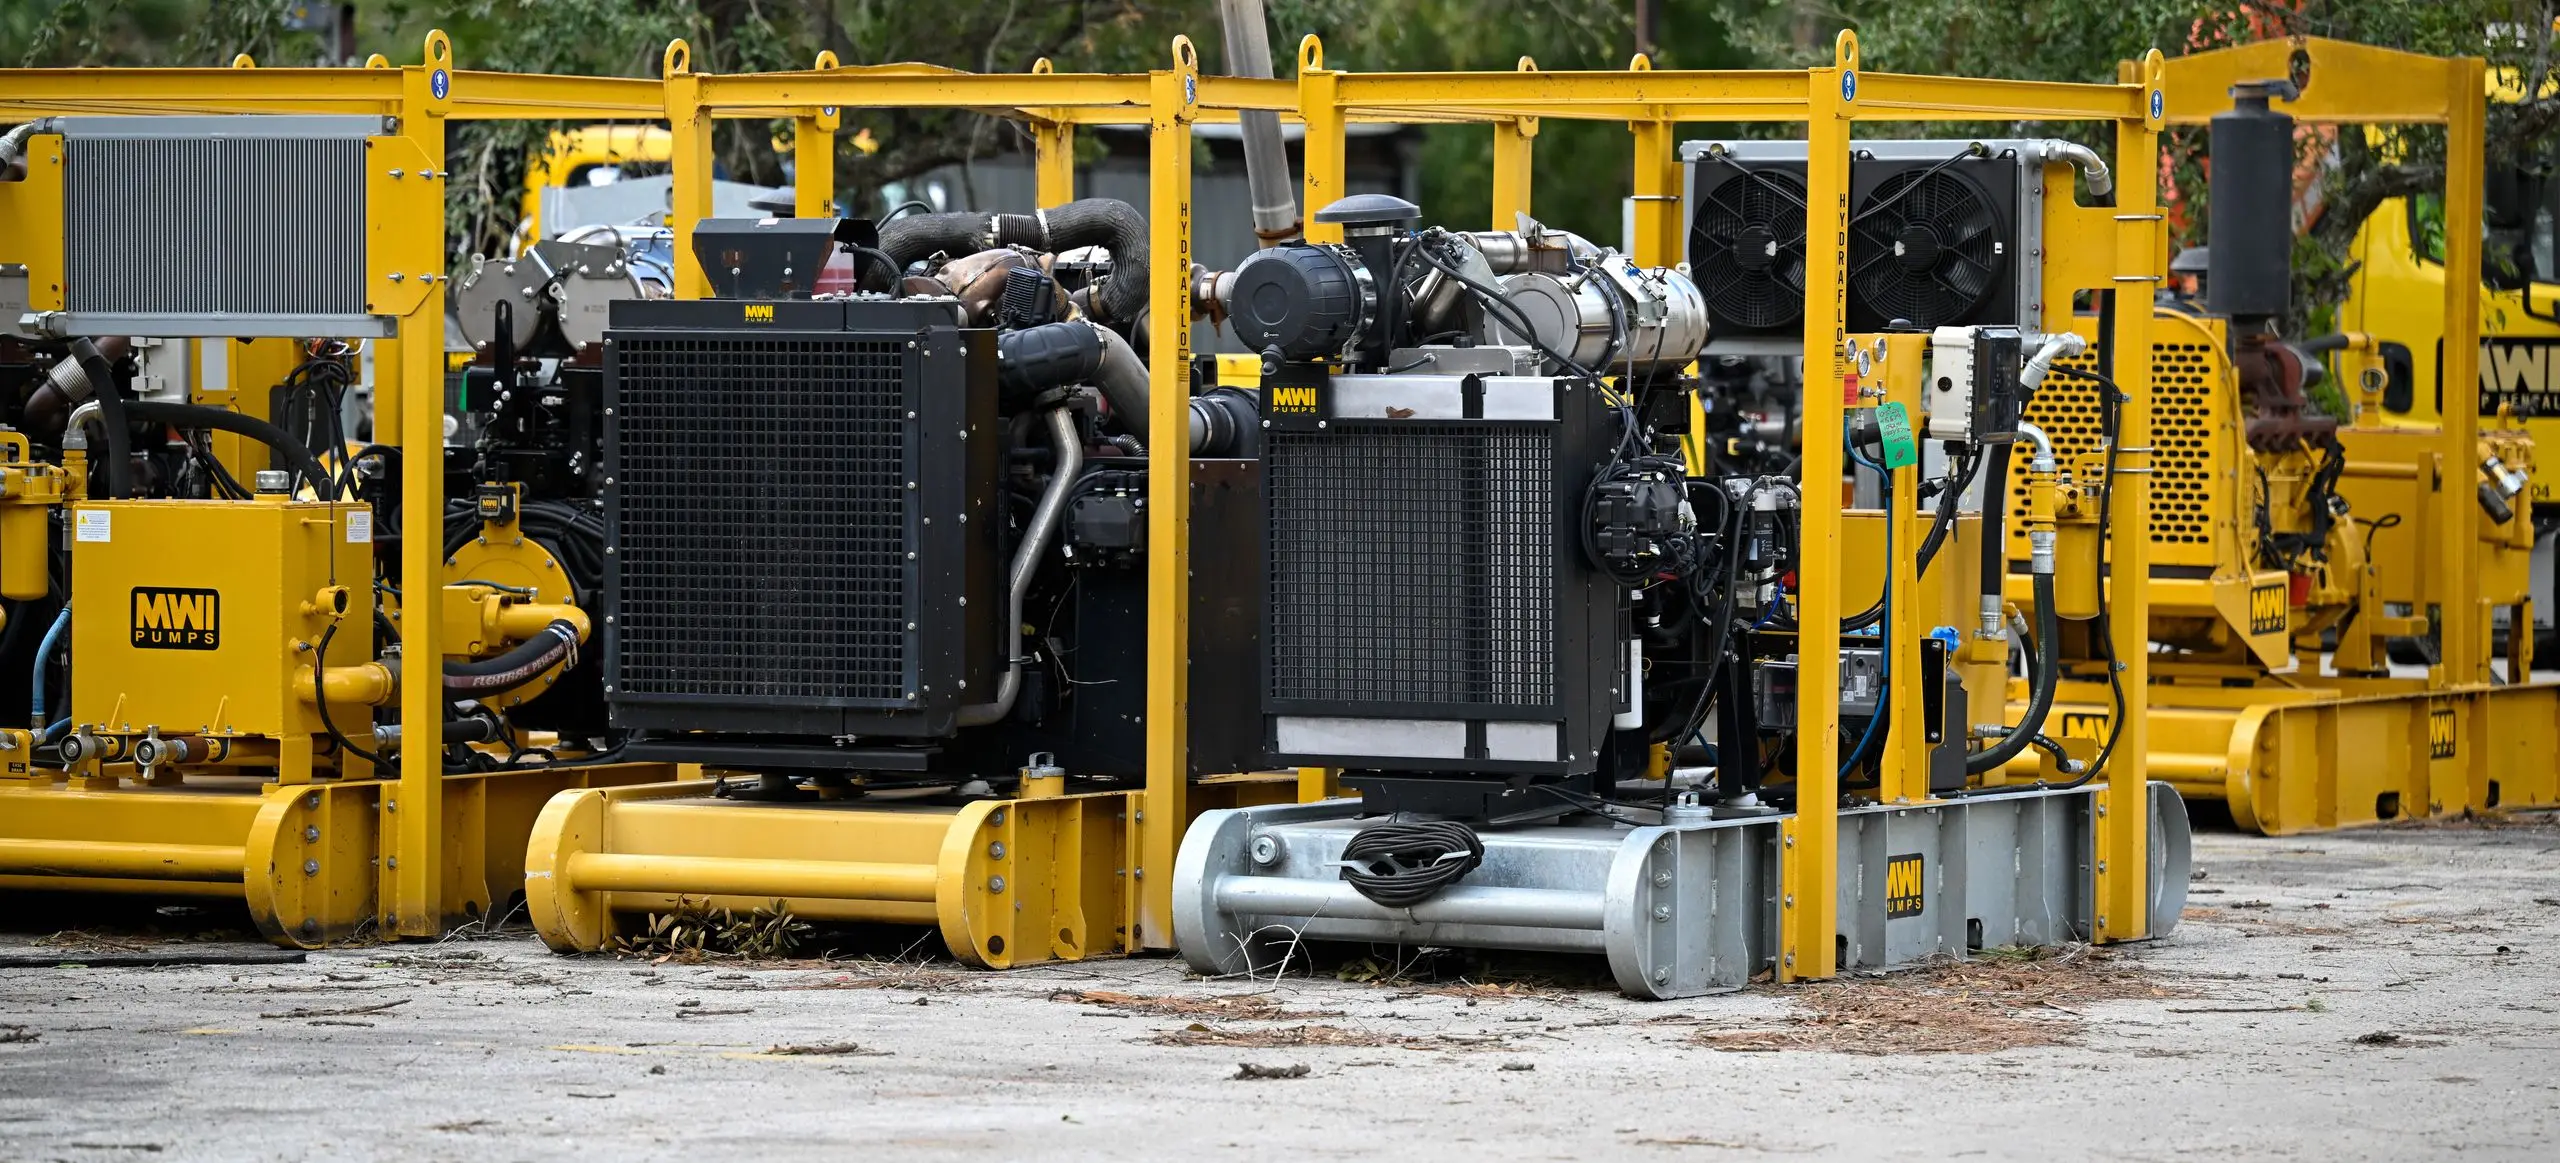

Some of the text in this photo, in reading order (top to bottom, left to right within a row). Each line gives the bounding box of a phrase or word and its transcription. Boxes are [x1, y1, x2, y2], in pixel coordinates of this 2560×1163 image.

[1180, 202, 1188, 346] HYDRAFLO
[1836, 193, 1846, 342] HYDRAFLO
[745, 305, 773, 318] MWI
[1273, 388, 1316, 406] MWI
[136, 593, 215, 630] MWI
[2252, 587, 2284, 620] MWI
[136, 631, 215, 644] PUMPS
[472, 667, 529, 687] FLEXTRAL
[1887, 898, 1921, 912] UMPS
